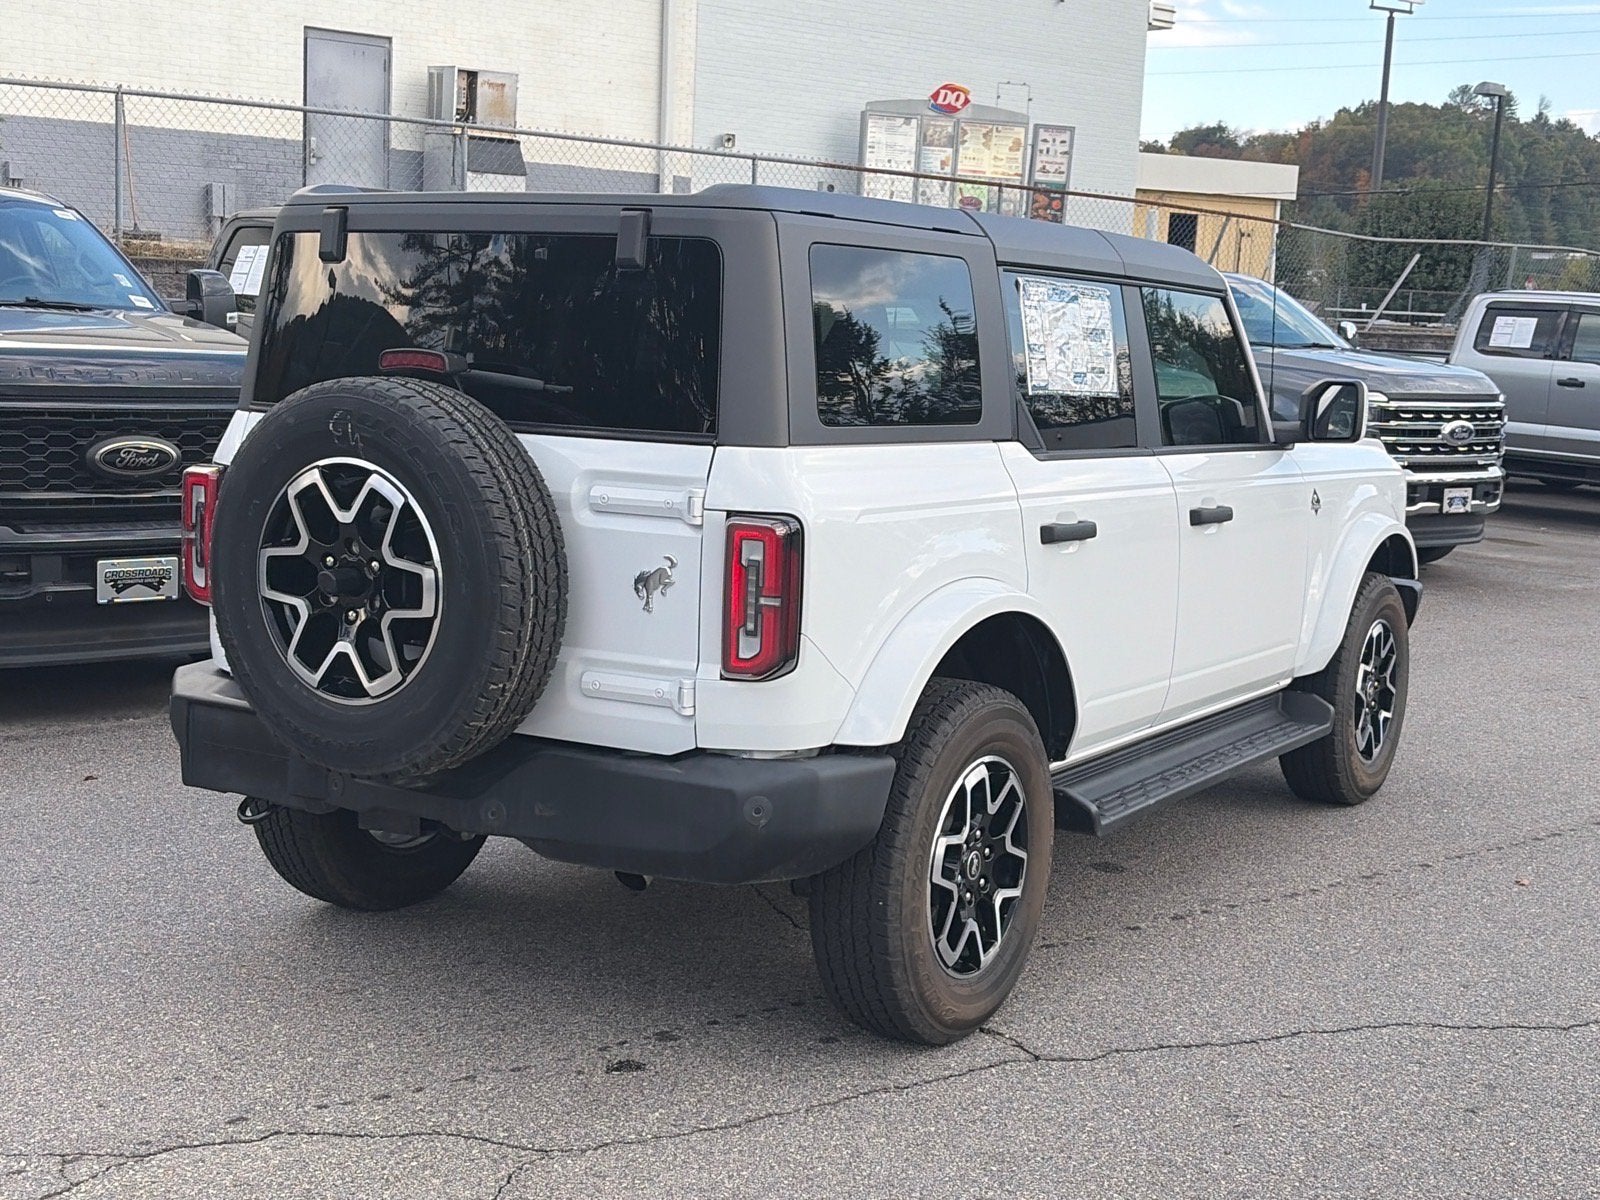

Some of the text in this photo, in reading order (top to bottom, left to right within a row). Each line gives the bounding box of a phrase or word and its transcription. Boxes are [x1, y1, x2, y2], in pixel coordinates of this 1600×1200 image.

[937, 90, 965, 108] DQ
[116, 447, 160, 468] Ford
[104, 567, 172, 579] CROSSROADS
